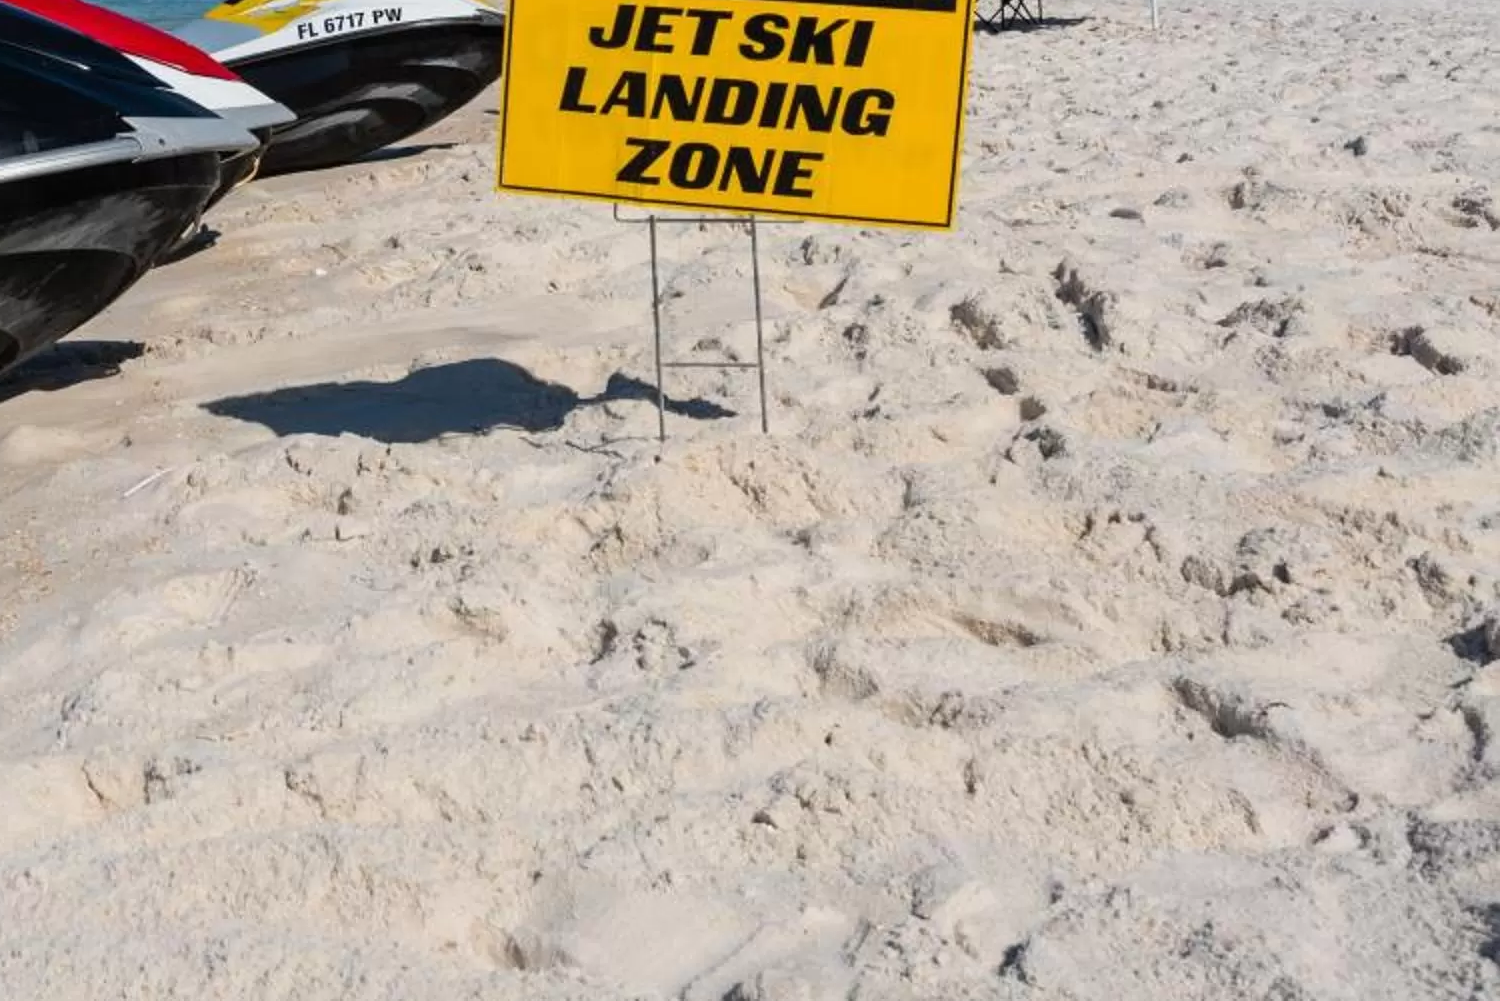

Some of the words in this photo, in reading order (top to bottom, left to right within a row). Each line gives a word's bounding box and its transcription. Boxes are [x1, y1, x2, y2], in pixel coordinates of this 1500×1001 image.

[297, 22, 319, 39] FL
[323, 12, 365, 33] 6717
[372, 7, 403, 24] PW
[589, 4, 733, 56] JET
[738, 11, 875, 68] SKI
[558, 66, 895, 137] LANDING
[616, 137, 824, 198] ZONE
